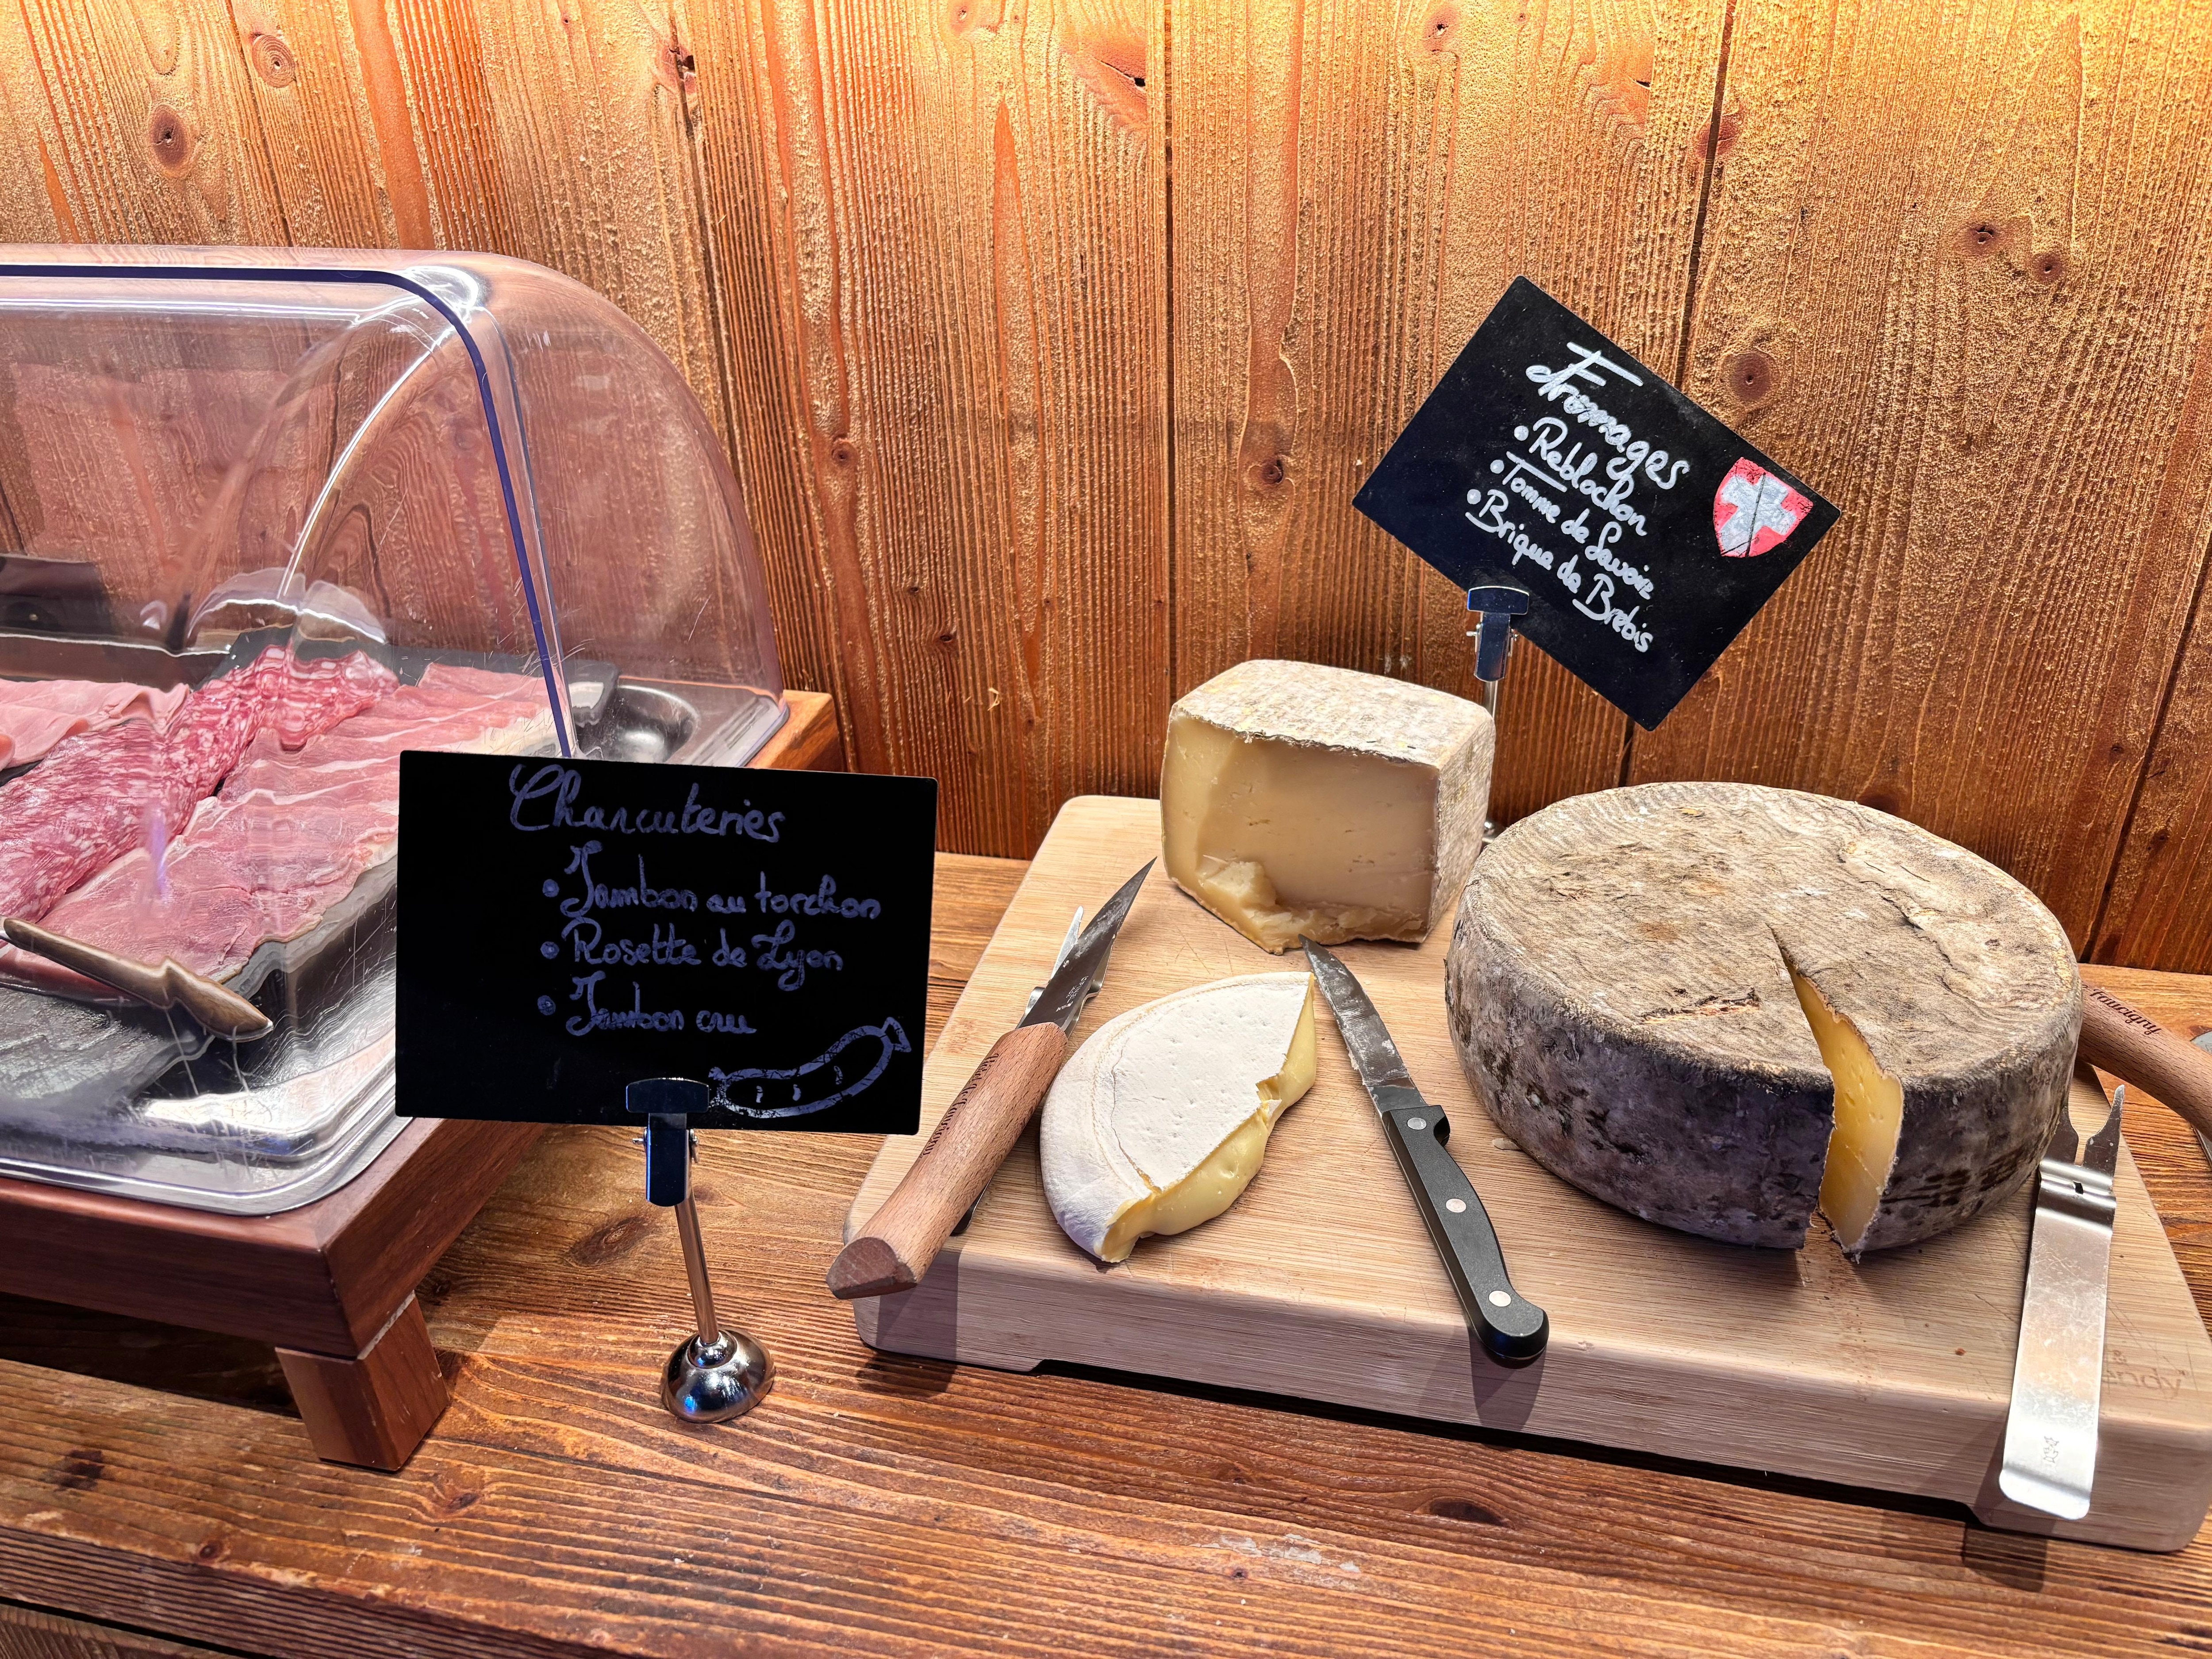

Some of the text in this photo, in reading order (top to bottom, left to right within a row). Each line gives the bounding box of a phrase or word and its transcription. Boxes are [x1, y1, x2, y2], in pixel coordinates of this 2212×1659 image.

[1525, 342, 1690, 490] Fromages
[1528, 416, 1647, 536] Reblochon
[1502, 451, 1654, 600] Tomme de Savoie
[1465, 489, 1654, 653] Brique de Brebis
[509, 764, 785, 843] Charcuteries
[560, 840, 881, 919] Jambon au torchon
[561, 917, 844, 991] Rosette de Lyon
[565, 970, 757, 1036] Jambon cru
[2089, 989, 2162, 1036] Faucigny
